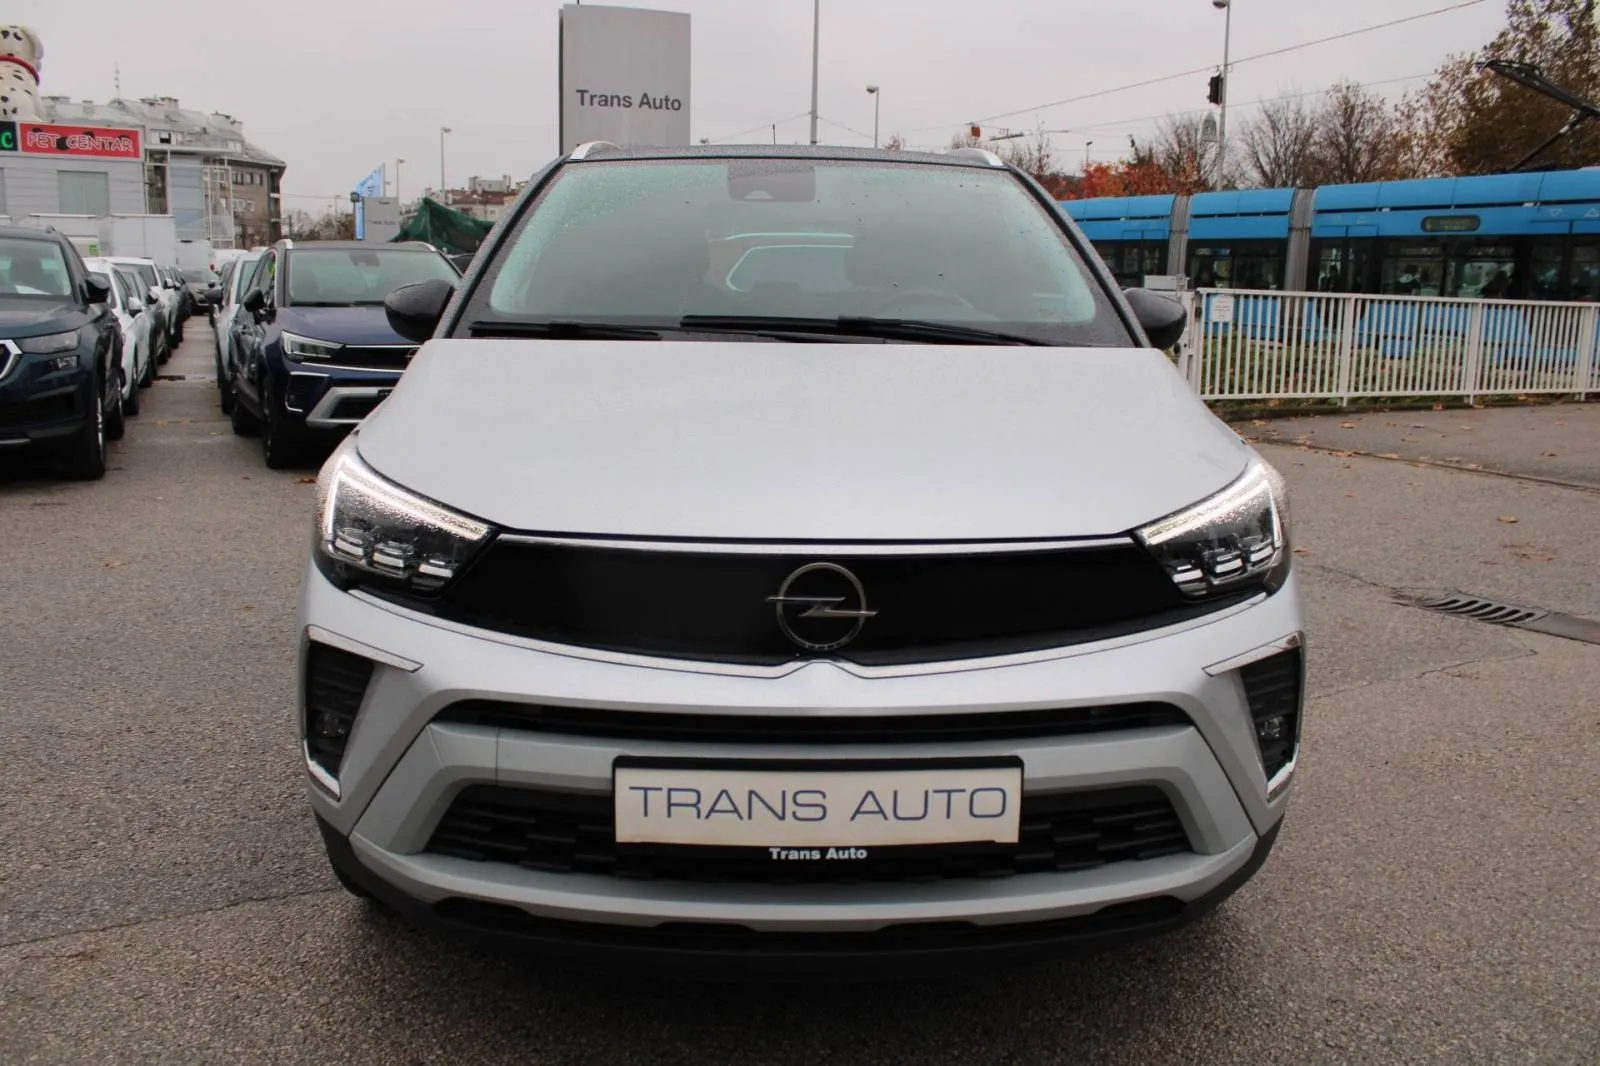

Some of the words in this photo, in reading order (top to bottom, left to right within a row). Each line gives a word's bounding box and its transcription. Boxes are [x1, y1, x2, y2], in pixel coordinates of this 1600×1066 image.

[576, 89, 633, 108] Trans
[638, 92, 682, 111] Auto
[27, 131, 60, 149] PET
[65, 133, 135, 153] CENTAR
[628, 786, 828, 822] TRANS
[850, 787, 1007, 822] AUTO
[769, 847, 821, 860] Trans
[826, 847, 868, 860] Auto
